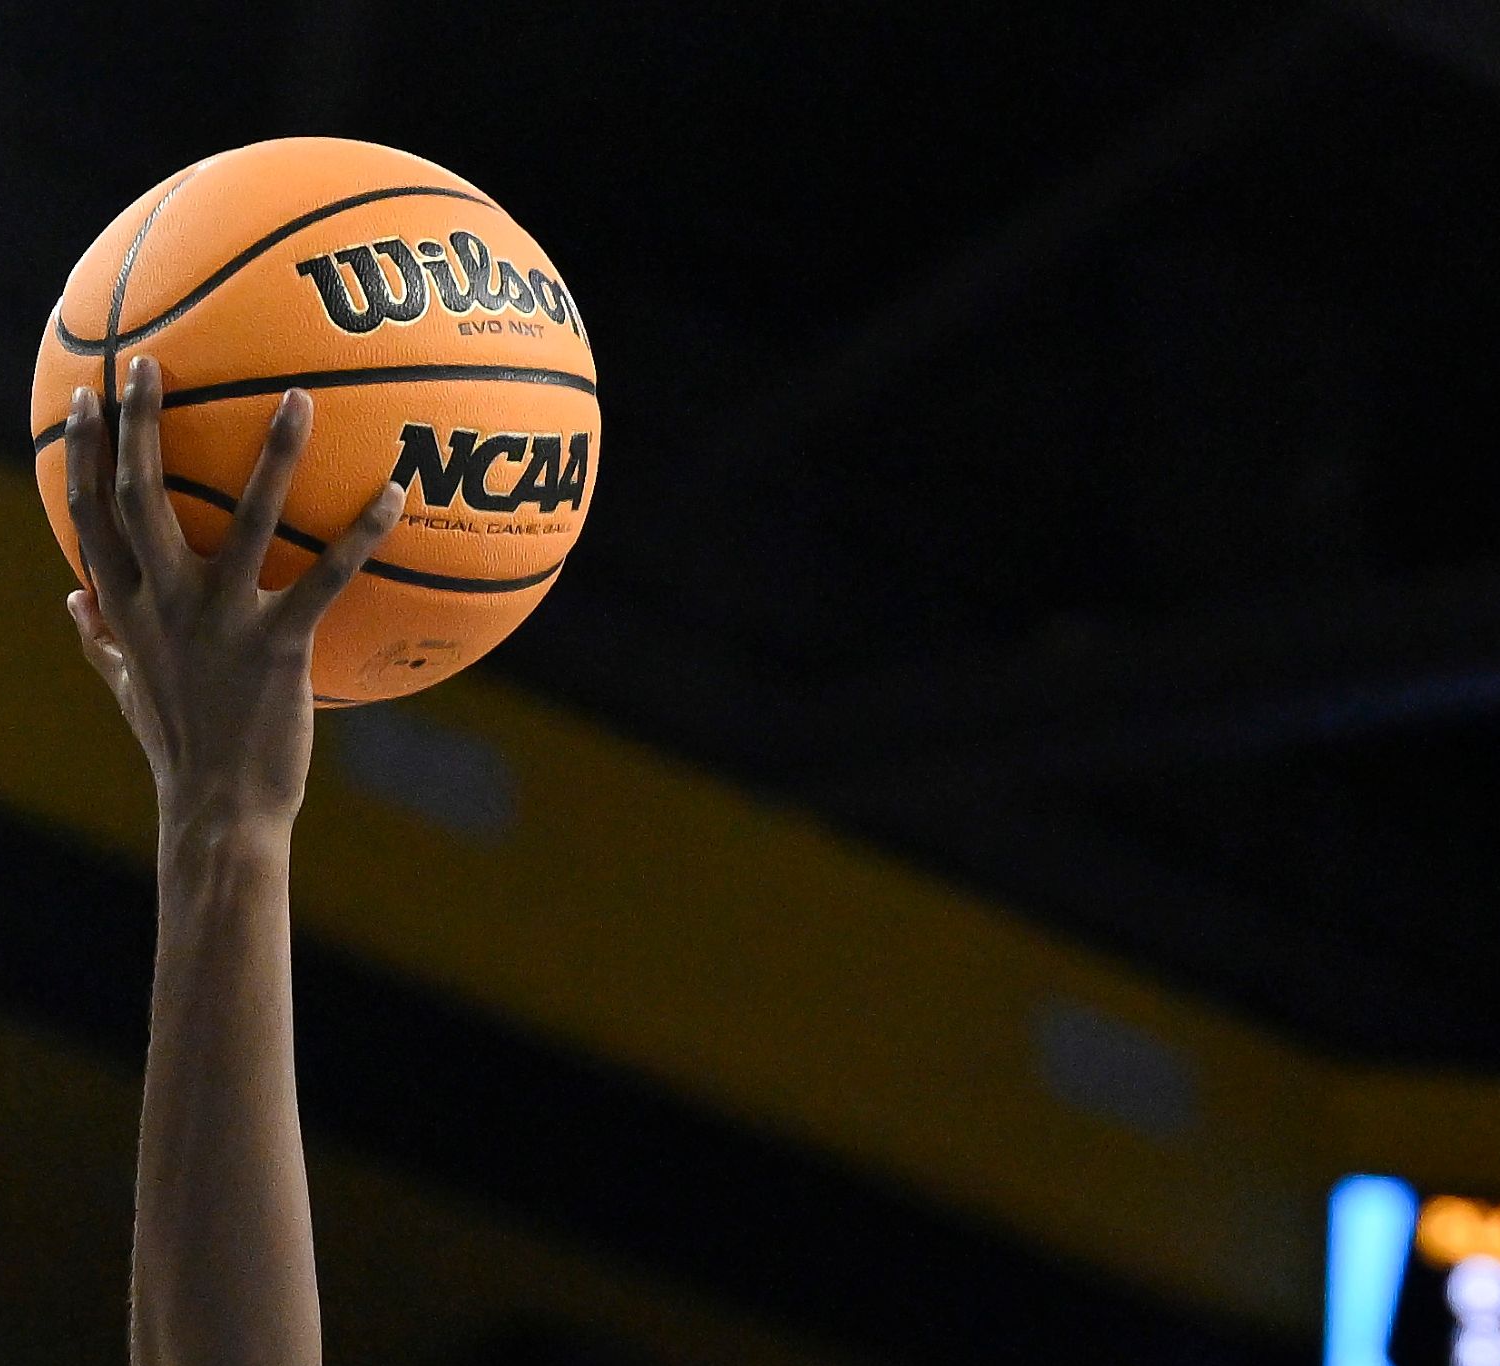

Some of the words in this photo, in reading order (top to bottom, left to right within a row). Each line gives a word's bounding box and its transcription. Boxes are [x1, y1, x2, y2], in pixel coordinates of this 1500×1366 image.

[457, 319, 502, 337] EVO
[508, 320, 546, 338] NXT
[388, 422, 590, 513] NCAA
[399, 513, 480, 534] FICIAL
